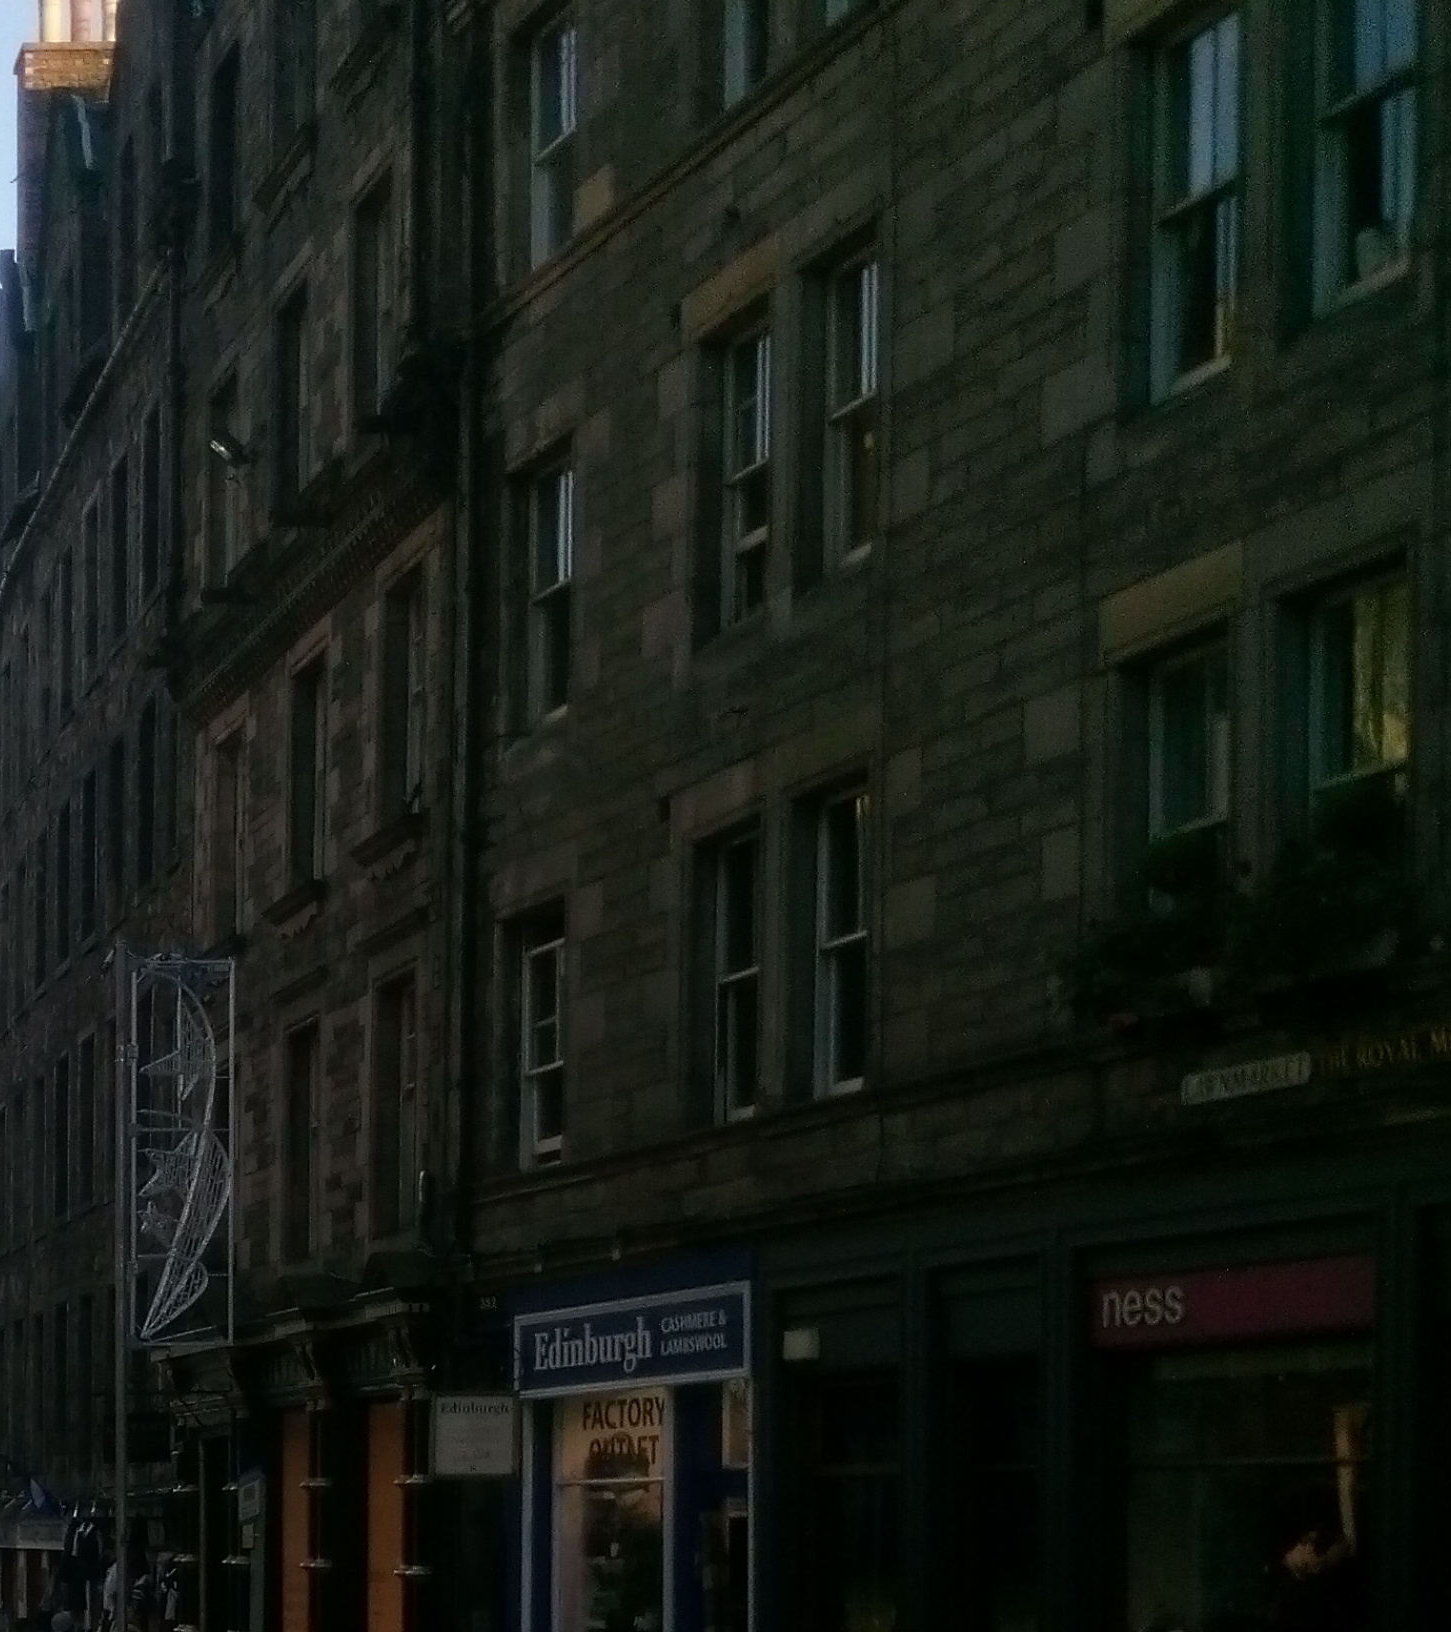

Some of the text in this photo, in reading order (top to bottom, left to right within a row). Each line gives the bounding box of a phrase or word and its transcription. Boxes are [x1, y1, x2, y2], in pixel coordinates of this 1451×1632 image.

[1102, 1284, 1185, 1329] ness
[534, 1316, 652, 1373] Edinburgh
[660, 1311, 716, 1334] CASHMERE
[660, 1333, 728, 1357] LAMBSWOOL
[440, 1401, 509, 1415] Edinburgh
[582, 1396, 664, 1431] FACTORY
